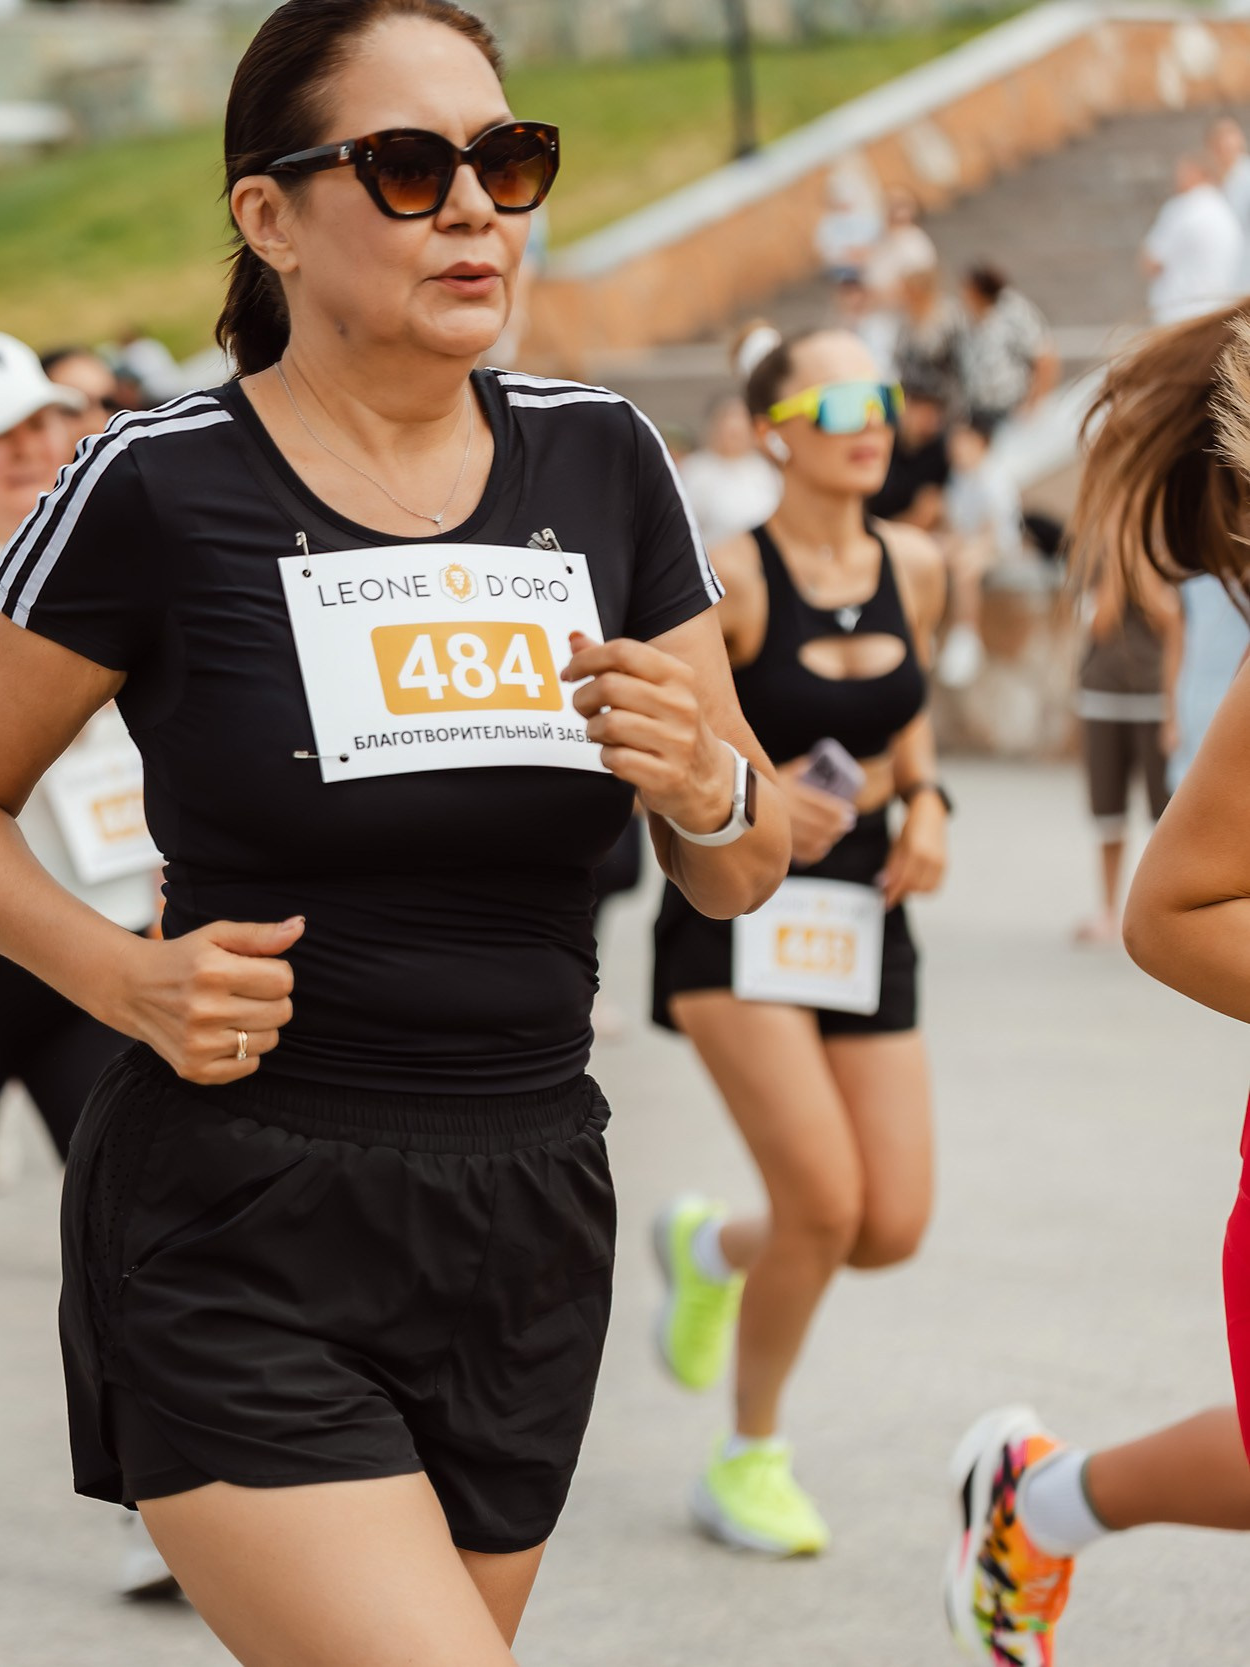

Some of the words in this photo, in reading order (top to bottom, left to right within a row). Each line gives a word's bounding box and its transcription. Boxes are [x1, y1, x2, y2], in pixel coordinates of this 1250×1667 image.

[318, 575, 431, 607] LEONE
[486, 575, 569, 602] D'ORO
[398, 633, 545, 700] 484
[354, 722, 554, 750] БЛАГОТВОРИТЕЛЬНЫЙ
